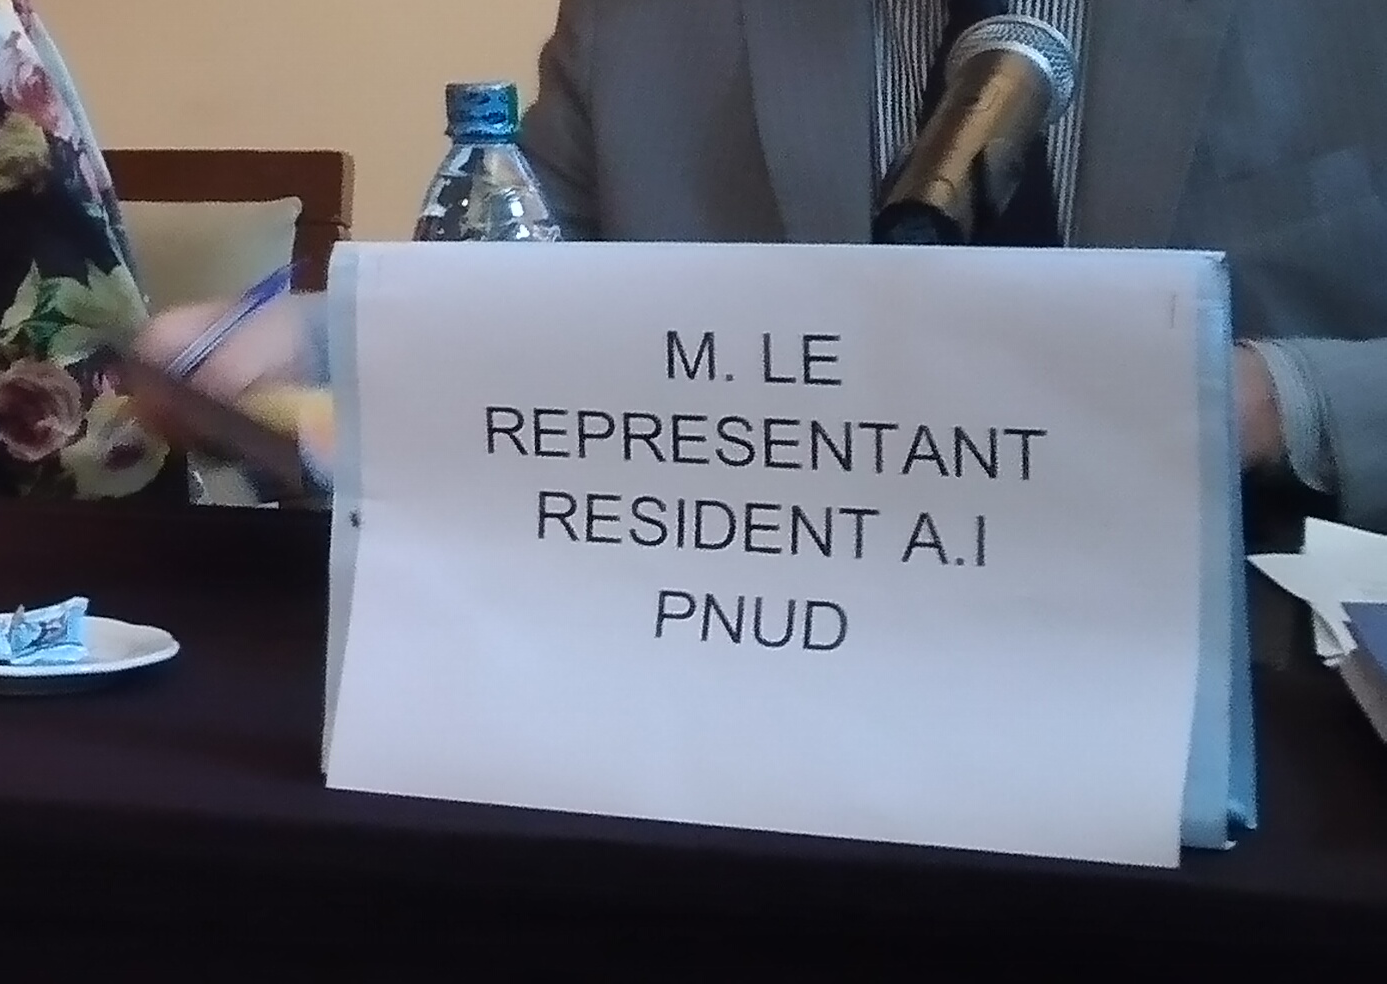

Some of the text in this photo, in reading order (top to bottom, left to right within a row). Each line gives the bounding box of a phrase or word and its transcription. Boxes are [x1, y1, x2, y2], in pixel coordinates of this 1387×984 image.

[666, 329, 843, 387] M. LE
[485, 405, 1048, 481] REPRESENTANT
[537, 490, 986, 568] RESIDENT A.I
[653, 589, 849, 652] PNUD
